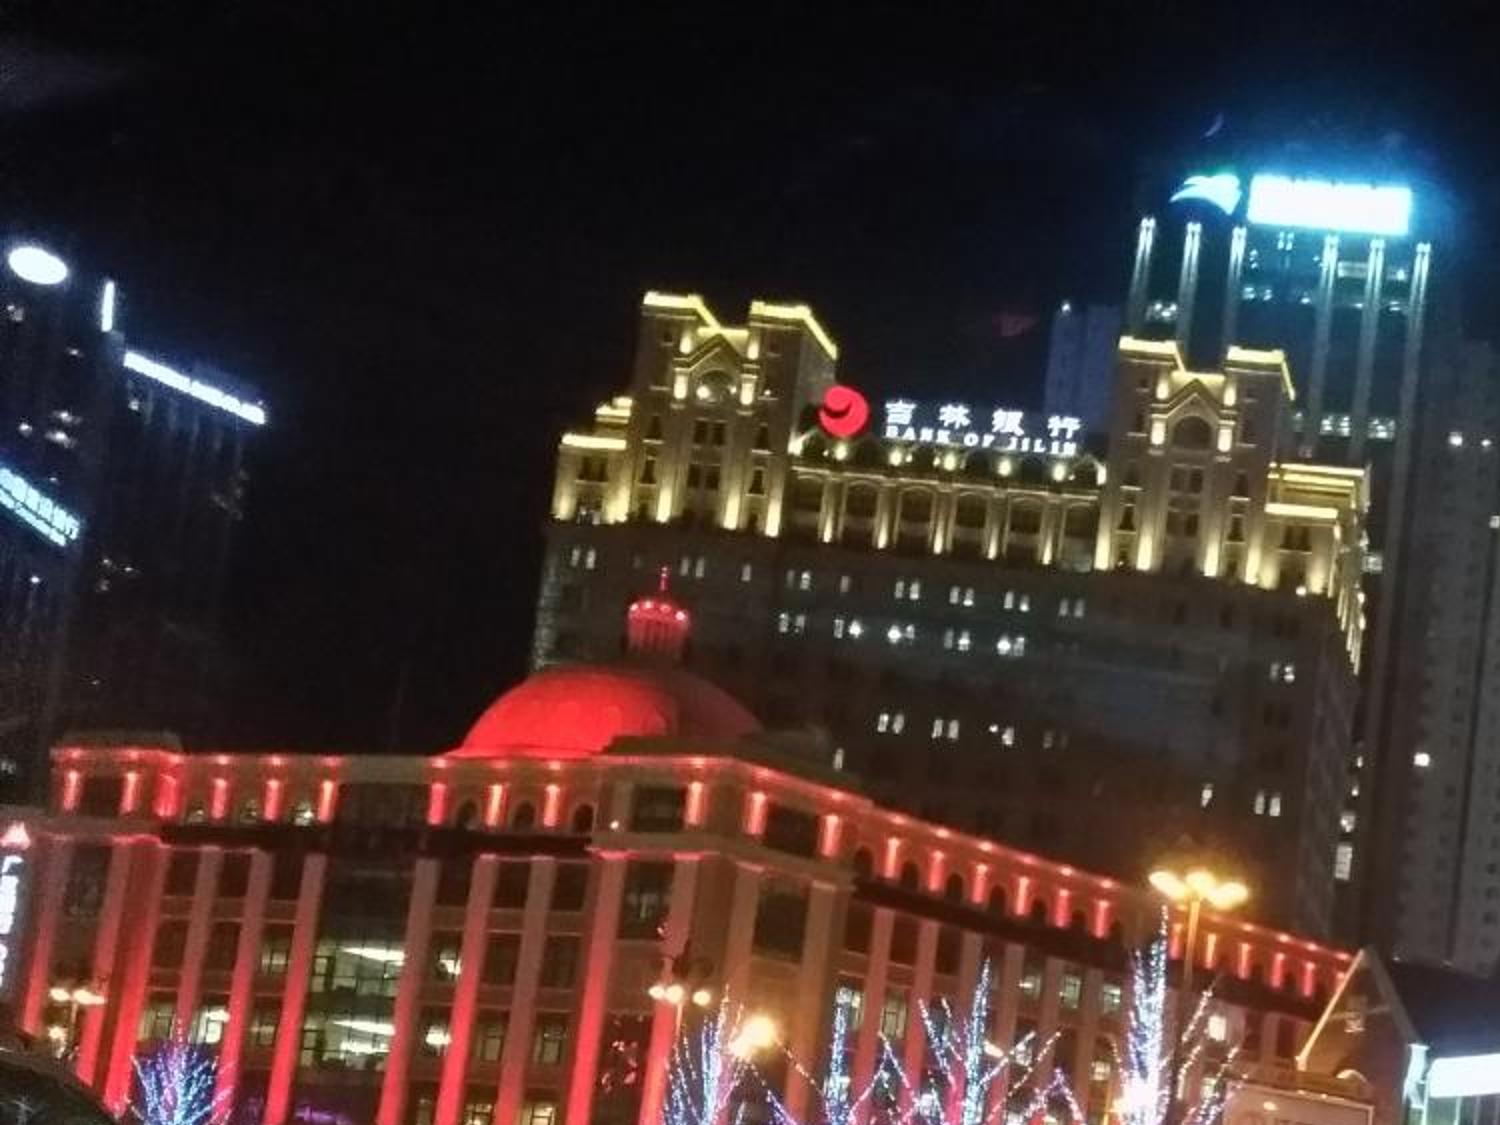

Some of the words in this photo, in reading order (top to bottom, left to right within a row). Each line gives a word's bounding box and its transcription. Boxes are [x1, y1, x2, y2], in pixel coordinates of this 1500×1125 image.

[885, 399, 1082, 439] 吉林银行
[885, 424, 956, 444] BANK
[963, 432, 995, 449] OF
[1009, 436, 1078, 457] JILIN
